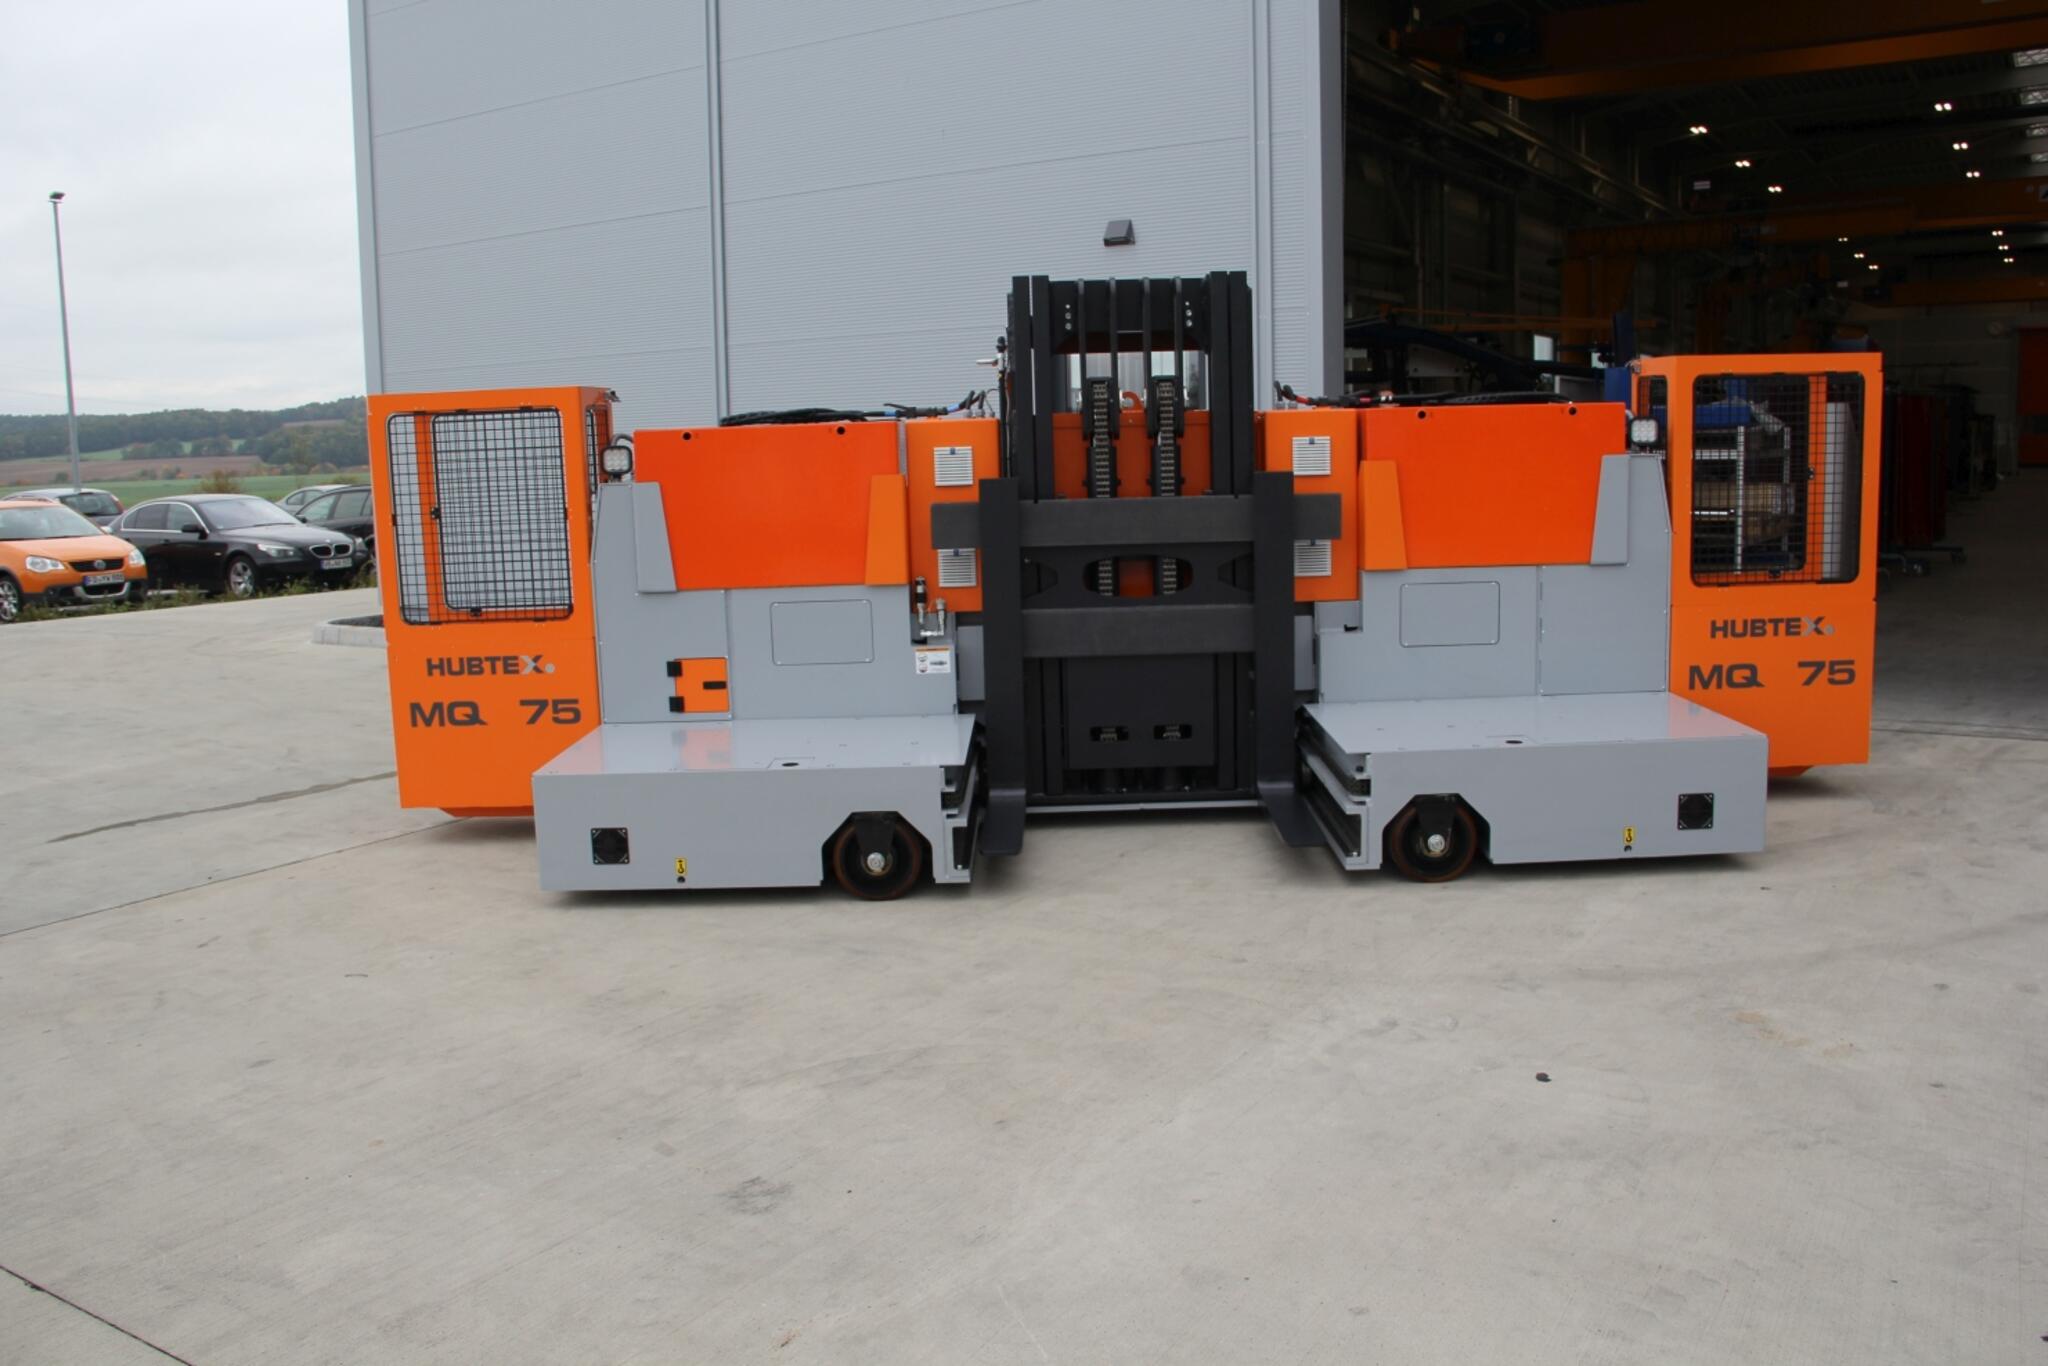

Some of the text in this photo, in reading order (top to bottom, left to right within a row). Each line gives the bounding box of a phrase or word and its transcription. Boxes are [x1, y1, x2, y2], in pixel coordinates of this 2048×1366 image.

[1688, 659, 1856, 690] MQ 75
[409, 698, 582, 728] MQ 75
